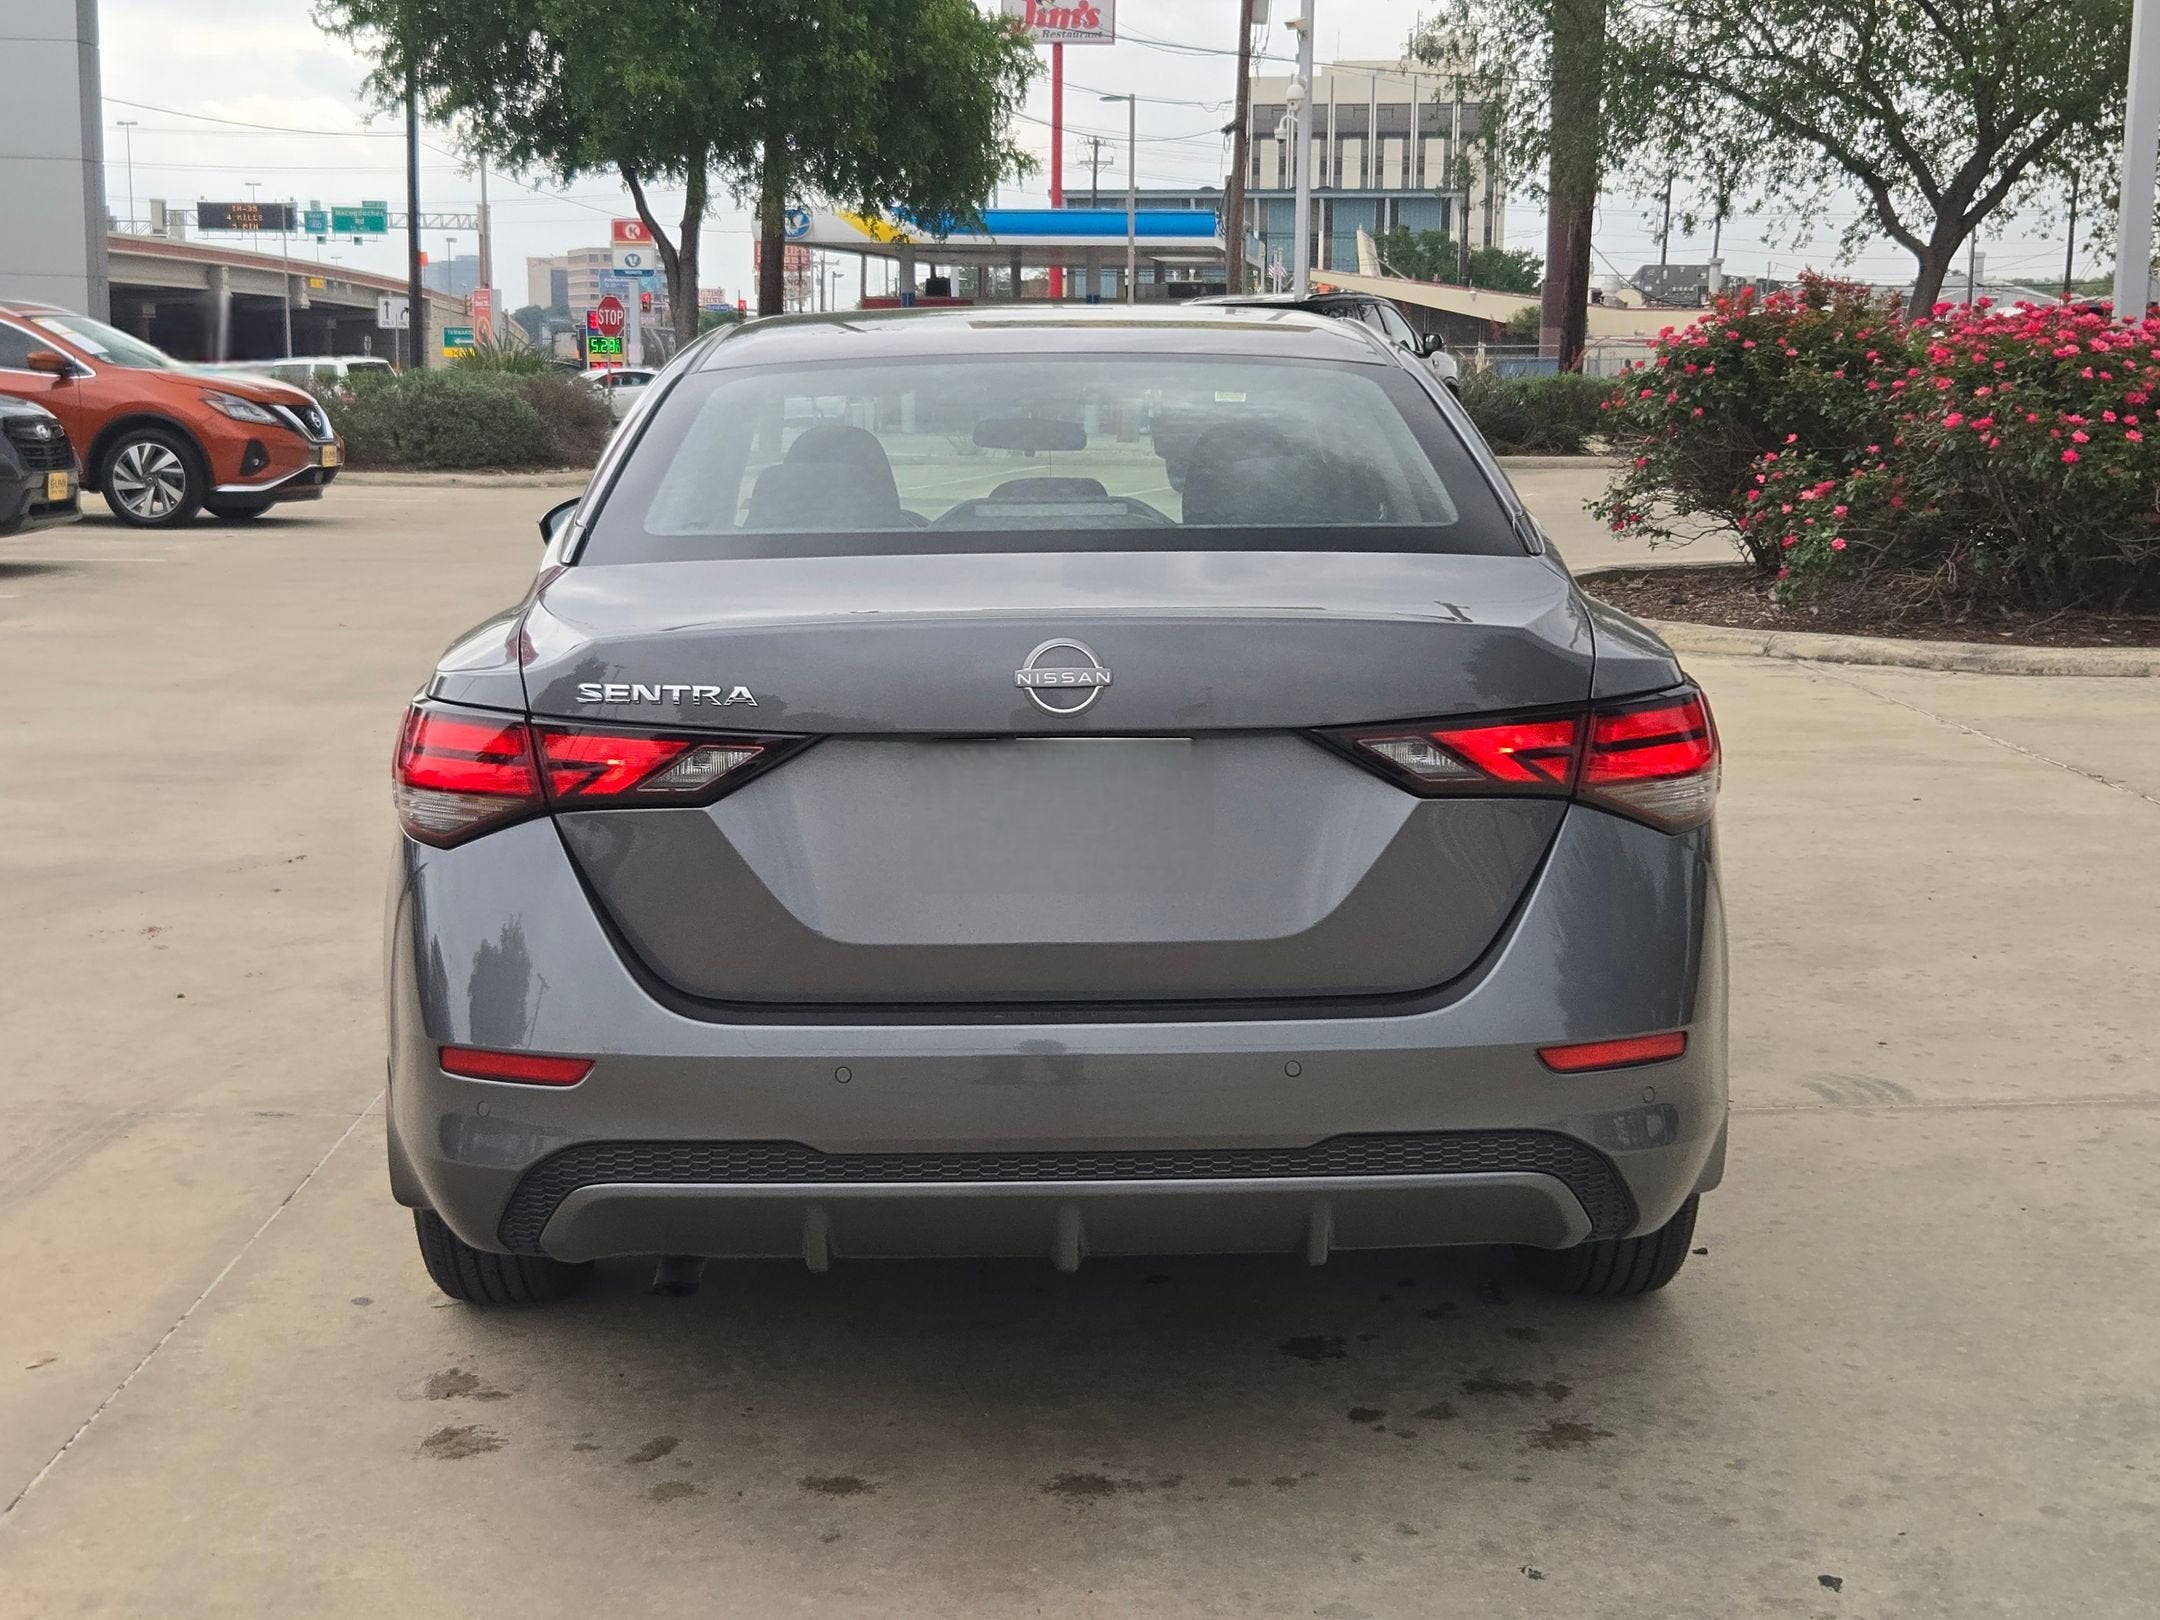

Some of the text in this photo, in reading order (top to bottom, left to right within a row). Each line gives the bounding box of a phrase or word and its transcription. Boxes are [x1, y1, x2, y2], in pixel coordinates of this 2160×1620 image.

[1025, 0, 1101, 30] Jim's
[1041, 29, 1103, 39] Restaurant
[598, 308, 624, 326] STOP
[1017, 672, 1111, 685] NISSAN
[576, 683, 758, 706] SENTRA
